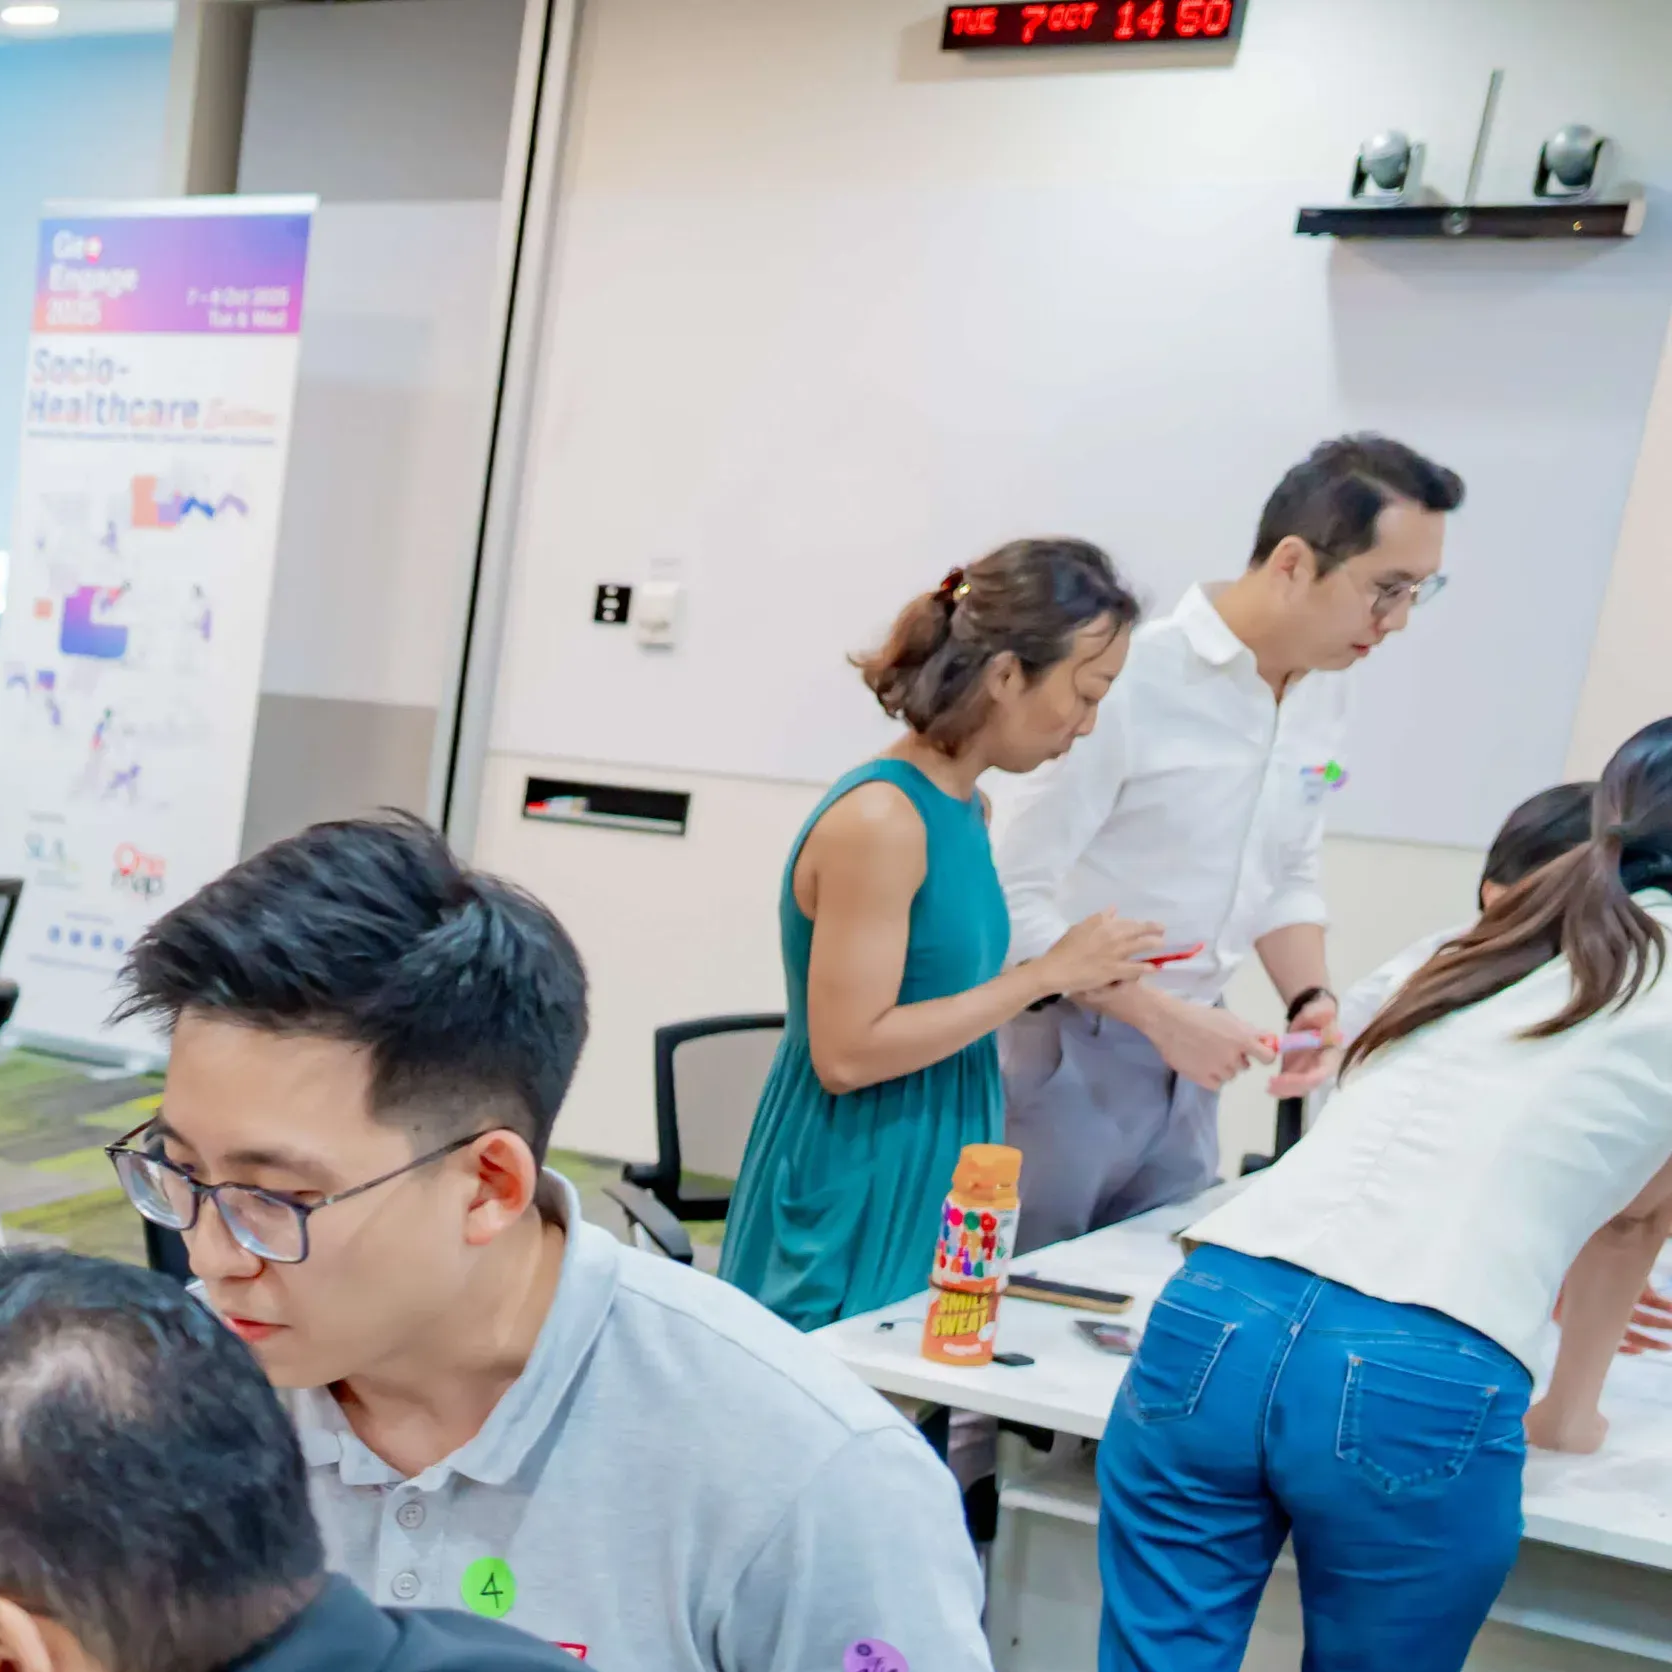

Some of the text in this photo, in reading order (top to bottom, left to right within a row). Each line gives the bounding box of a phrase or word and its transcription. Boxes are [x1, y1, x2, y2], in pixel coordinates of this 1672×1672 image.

[951, 8, 998, 35] TUE
[1021, 6, 1047, 43] 7
[1047, 3, 1099, 31] OCT
[1114, 0, 1164, 39] 14
[32, 347, 131, 386] Socio-
[26, 389, 200, 429] Healthcare
[479, 1572, 504, 1609] 4
